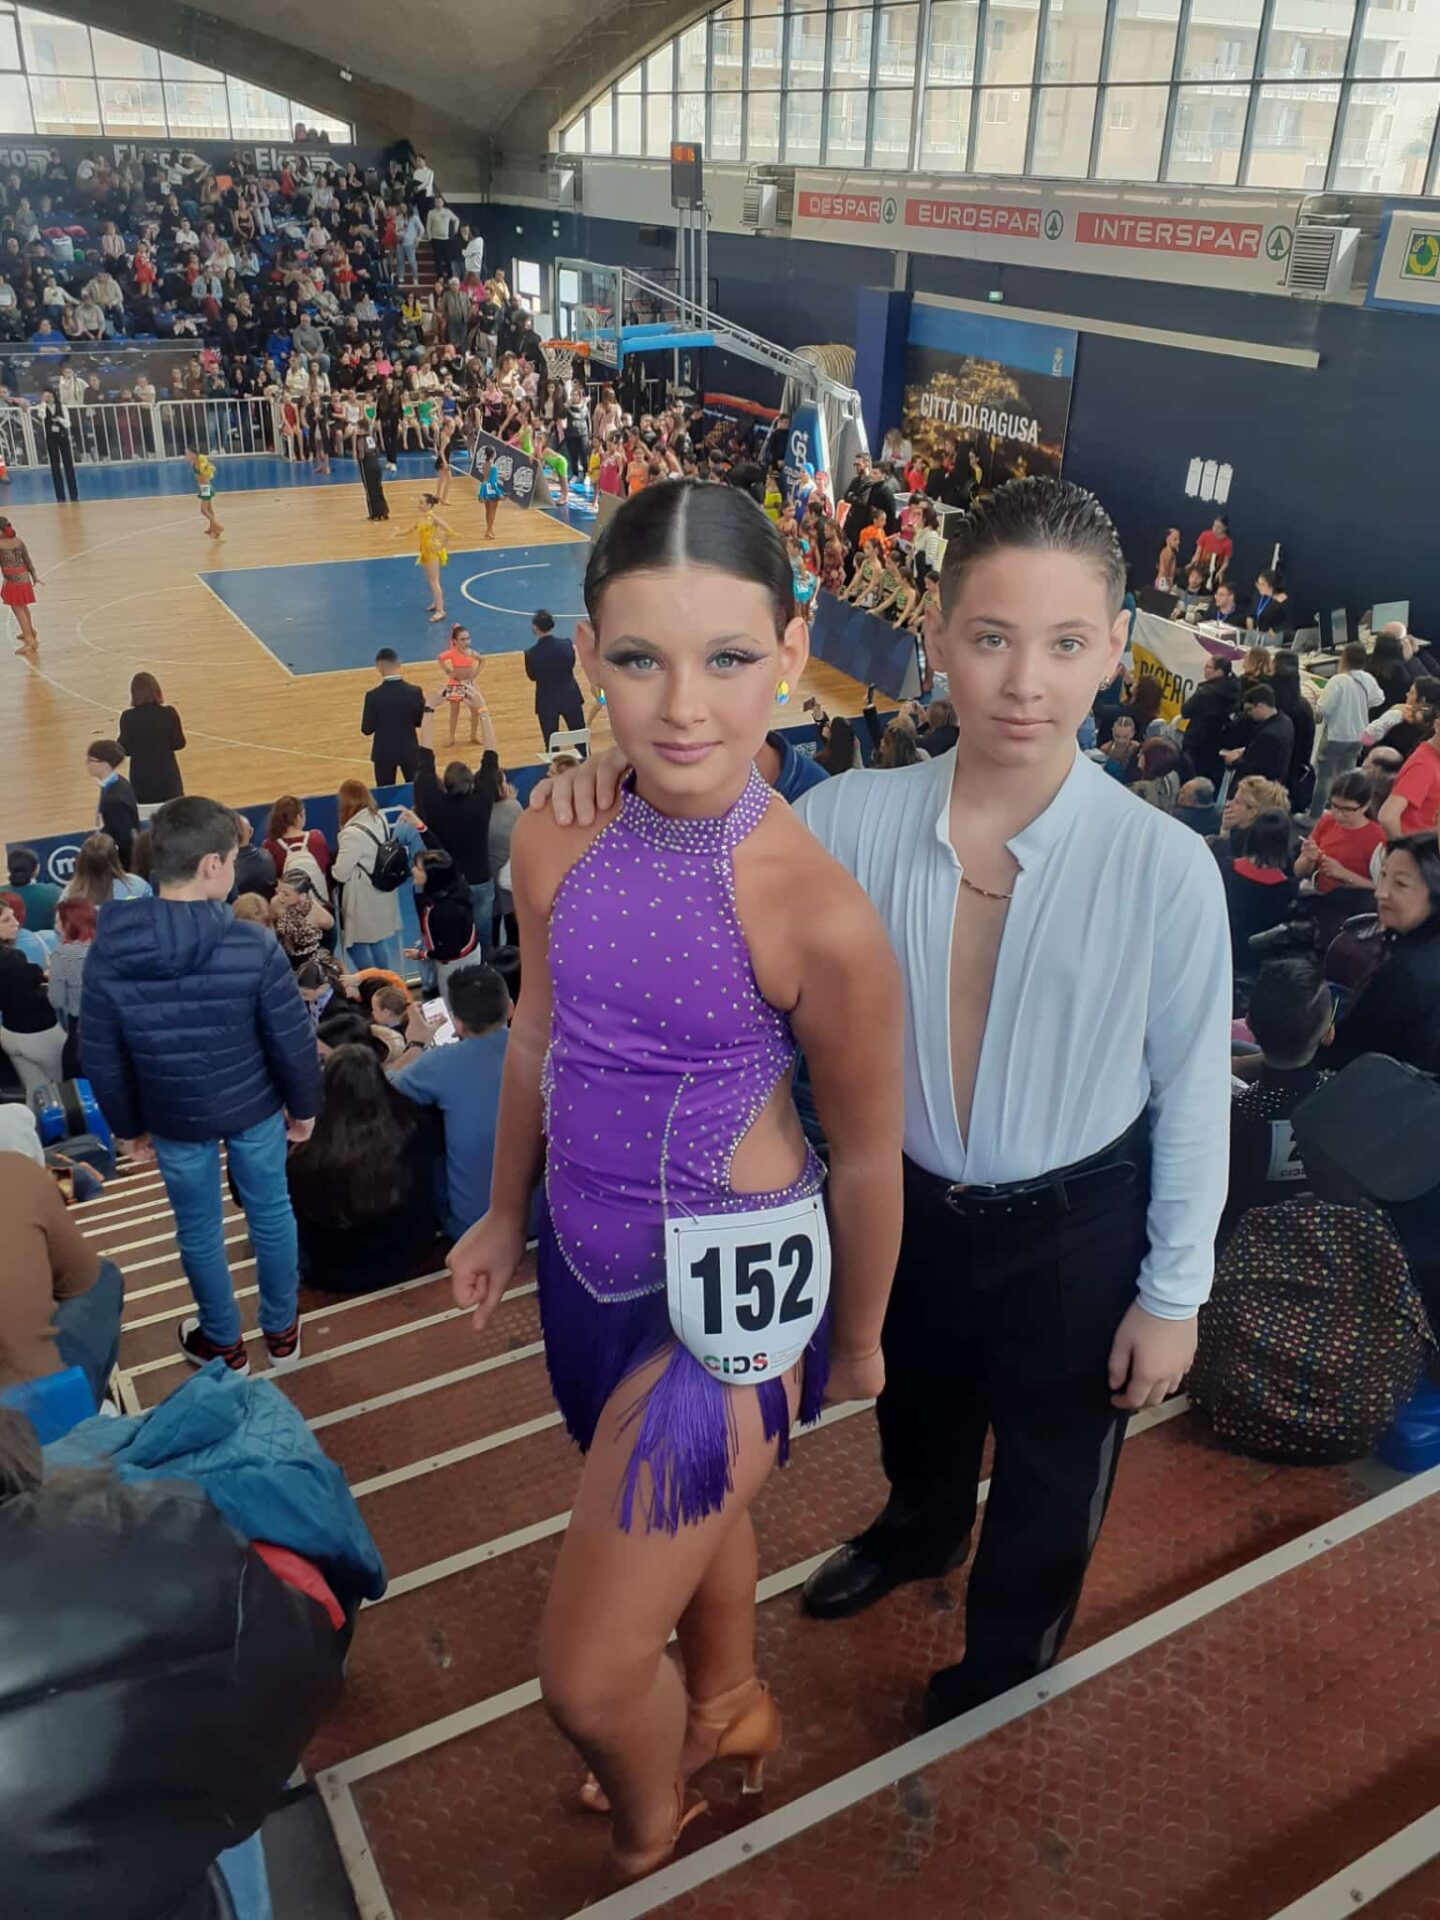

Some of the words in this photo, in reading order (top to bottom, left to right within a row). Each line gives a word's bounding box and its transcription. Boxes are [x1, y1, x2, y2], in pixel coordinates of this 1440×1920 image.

[809, 196, 881, 218] DESPAR
[918, 203, 1041, 233] EUROSPAR
[1093, 217, 1260, 252] INTERSPAR
[961, 403, 978, 429] DI
[979, 407, 1039, 447] RAGUSA
[690, 1233, 813, 1335] 152
